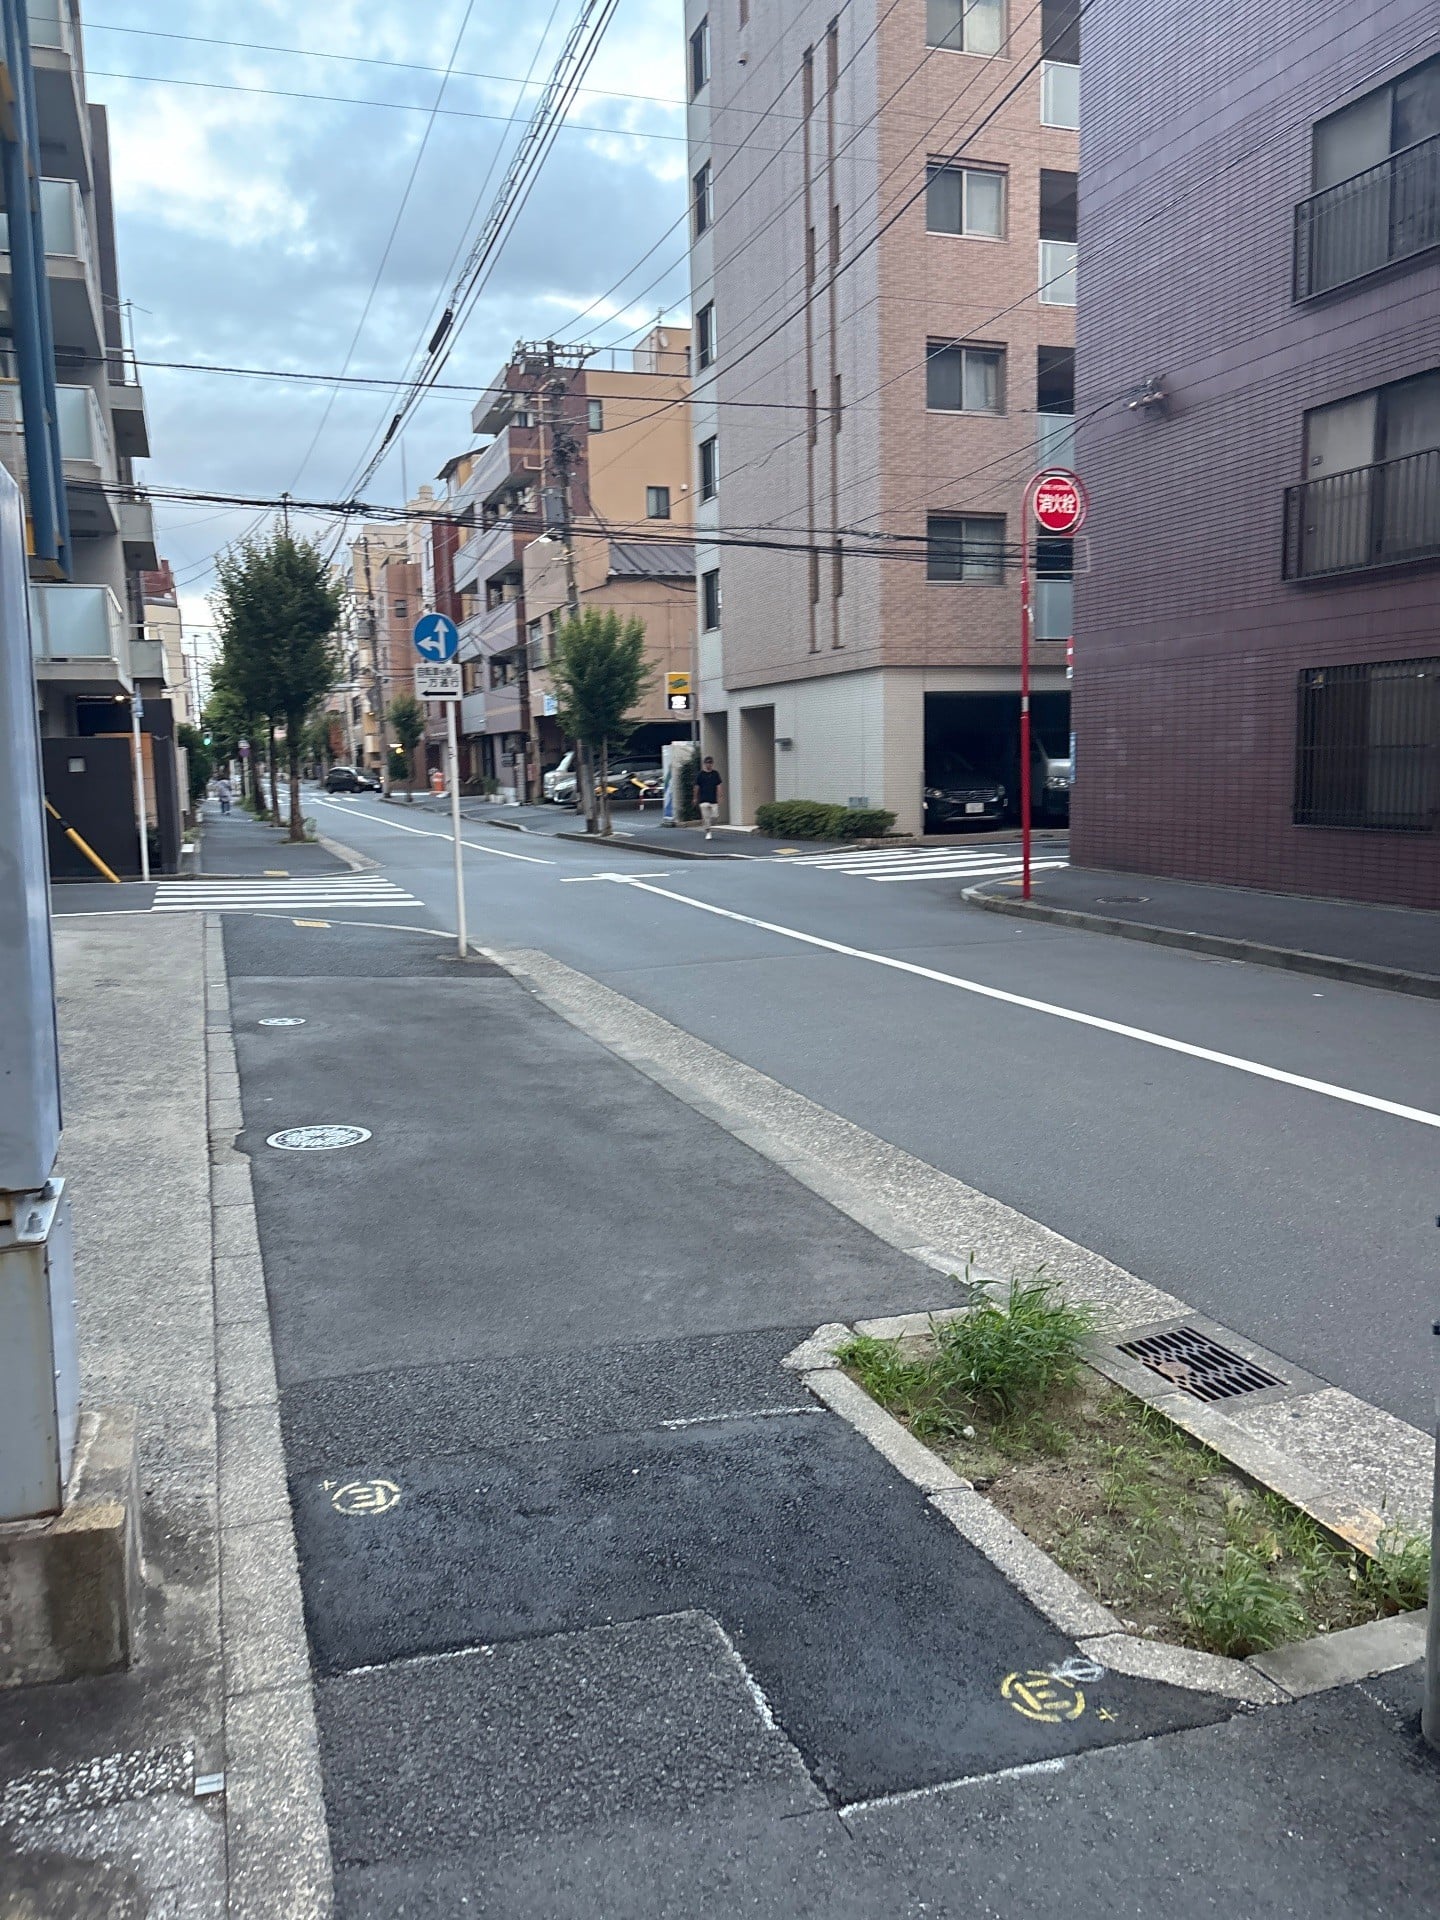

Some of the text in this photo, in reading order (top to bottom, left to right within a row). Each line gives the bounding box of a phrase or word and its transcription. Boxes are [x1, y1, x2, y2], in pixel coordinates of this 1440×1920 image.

[1038, 493, 1076, 513] 消火栓
[416, 678, 460, 688] 一方通行
